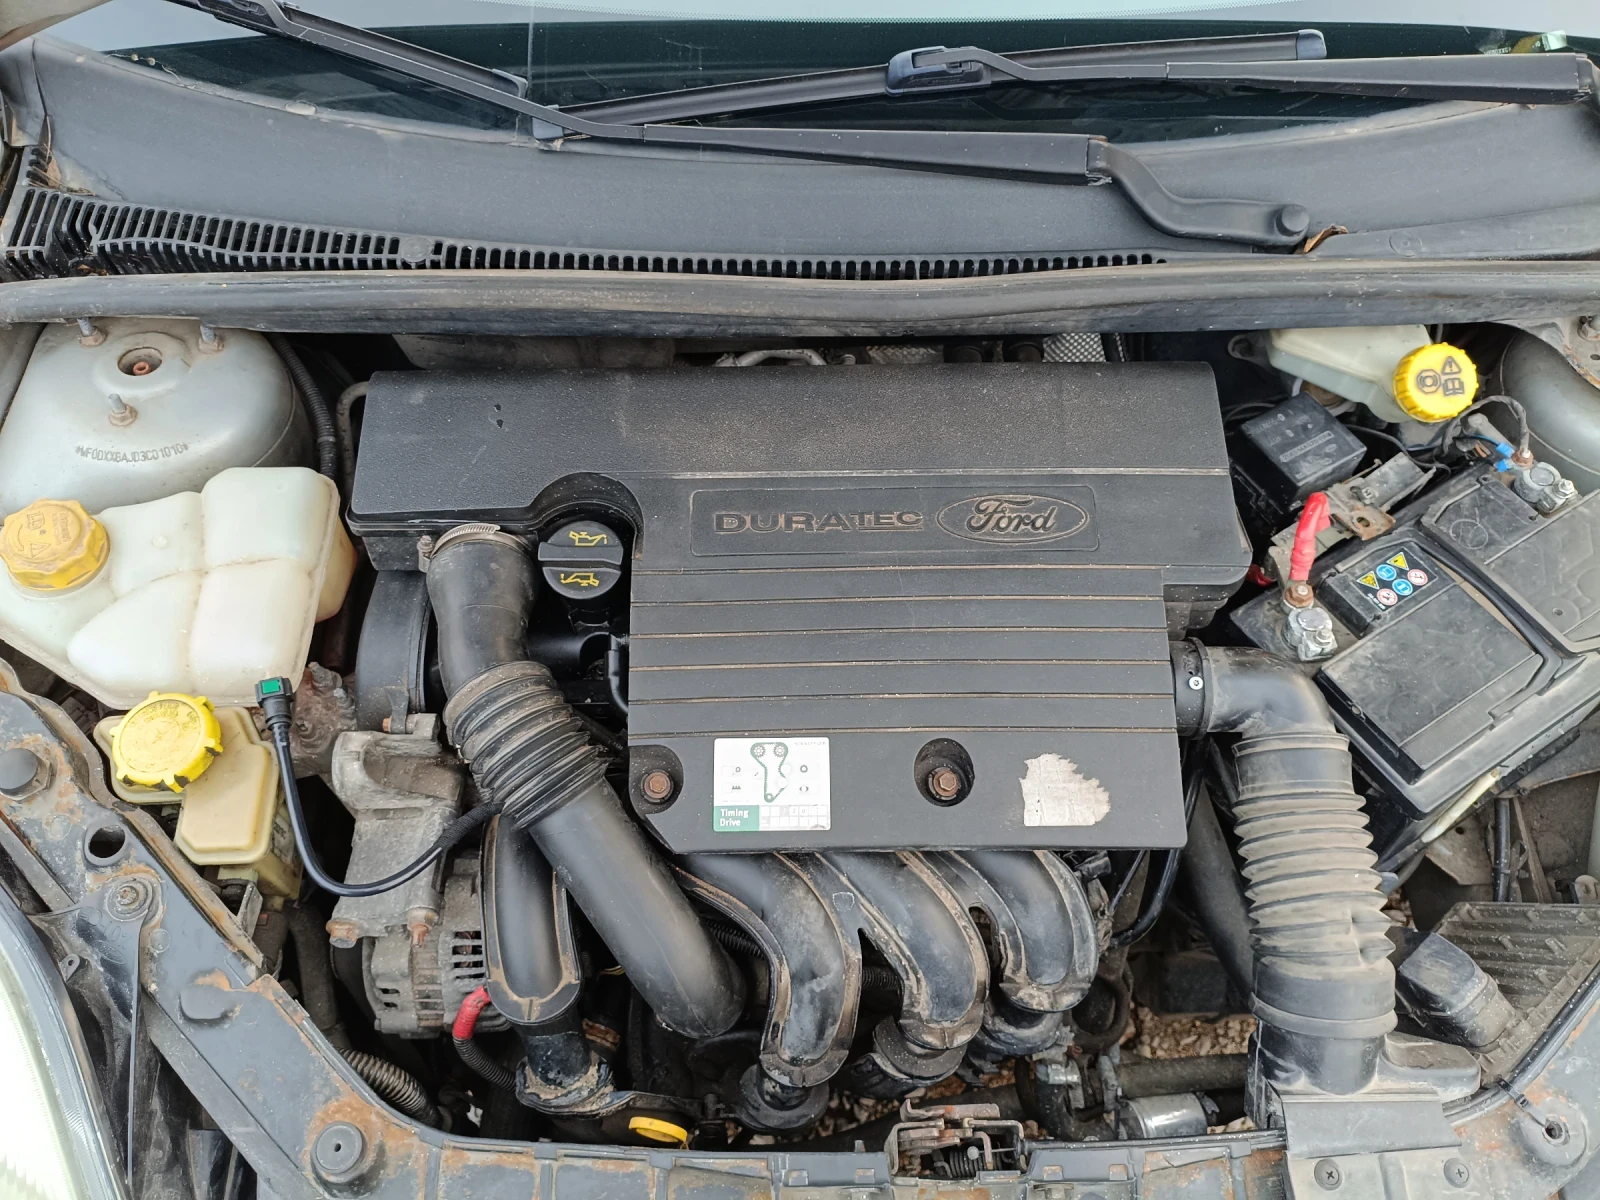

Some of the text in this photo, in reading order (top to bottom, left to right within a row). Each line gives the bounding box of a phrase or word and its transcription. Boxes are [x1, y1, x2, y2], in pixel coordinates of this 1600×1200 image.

[714, 511, 924, 534] DURATEC
[965, 497, 1056, 534] Ford
[720, 808, 750, 819] Timing
[719, 818, 741, 827] Drive
